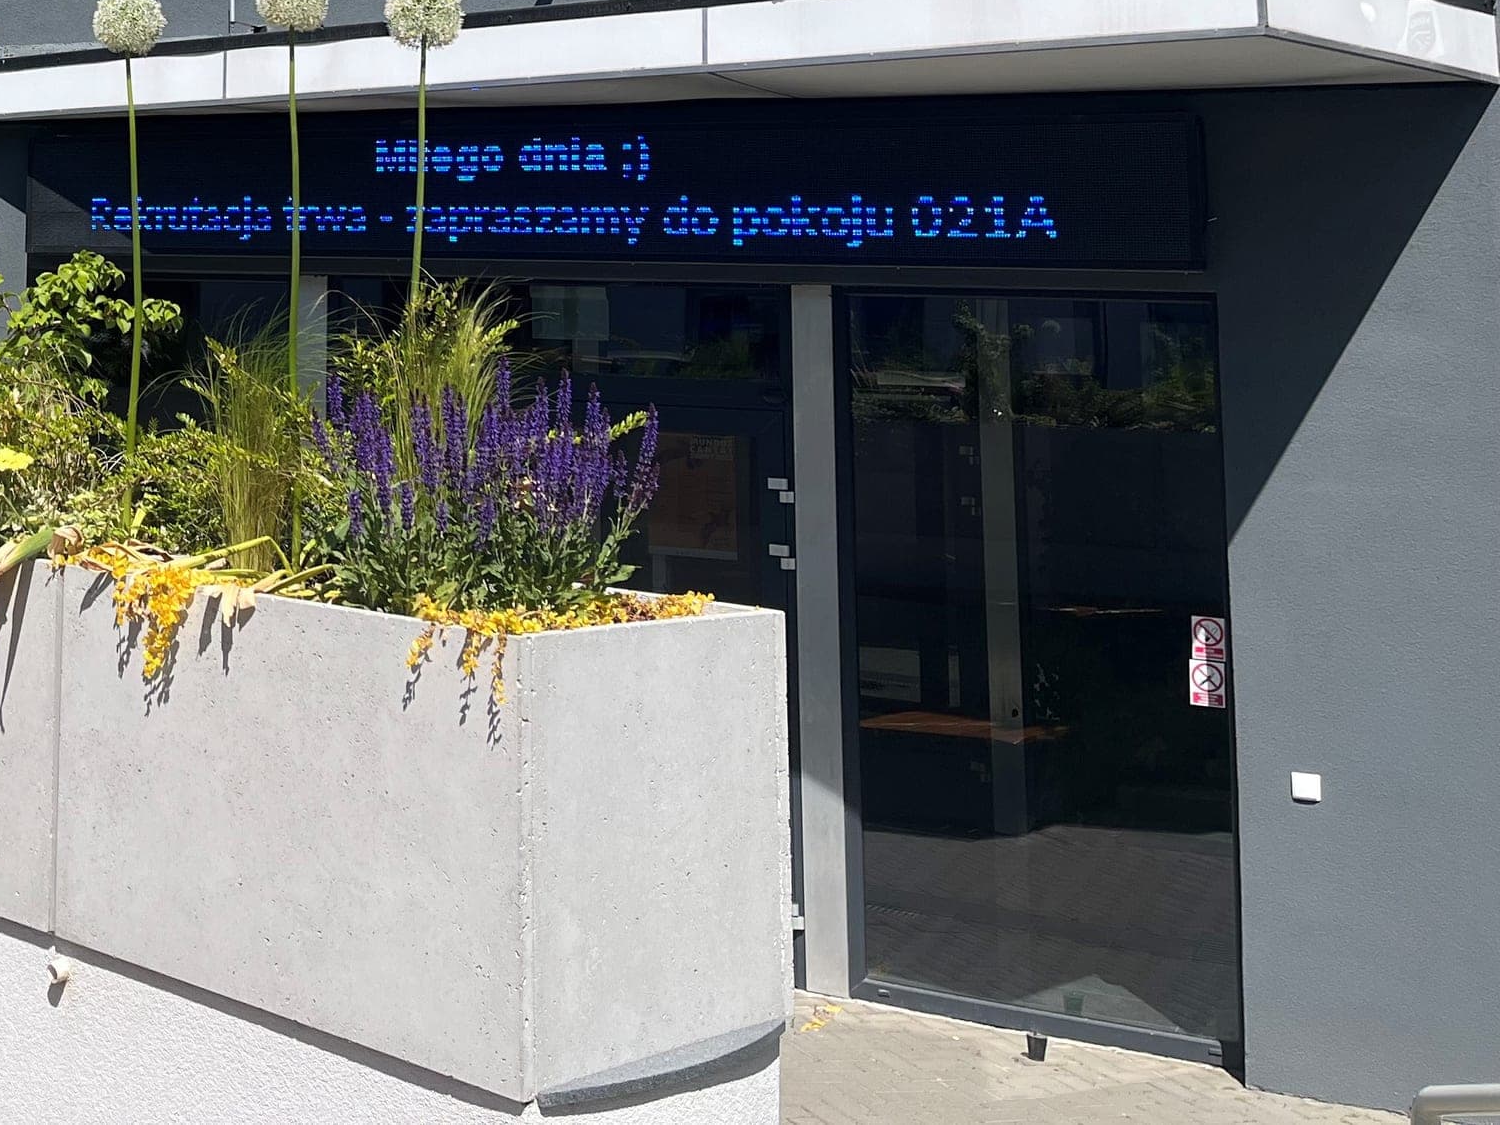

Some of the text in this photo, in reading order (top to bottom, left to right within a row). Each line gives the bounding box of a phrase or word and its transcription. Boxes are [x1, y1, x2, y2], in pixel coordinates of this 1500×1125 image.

[518, 136, 607, 172] dnia
[91, 195, 272, 241] Rekrutacja
[282, 195, 367, 232] trwa
[662, 194, 720, 235] do
[732, 194, 894, 247] pokoju
[910, 195, 1058, 239] 021A
